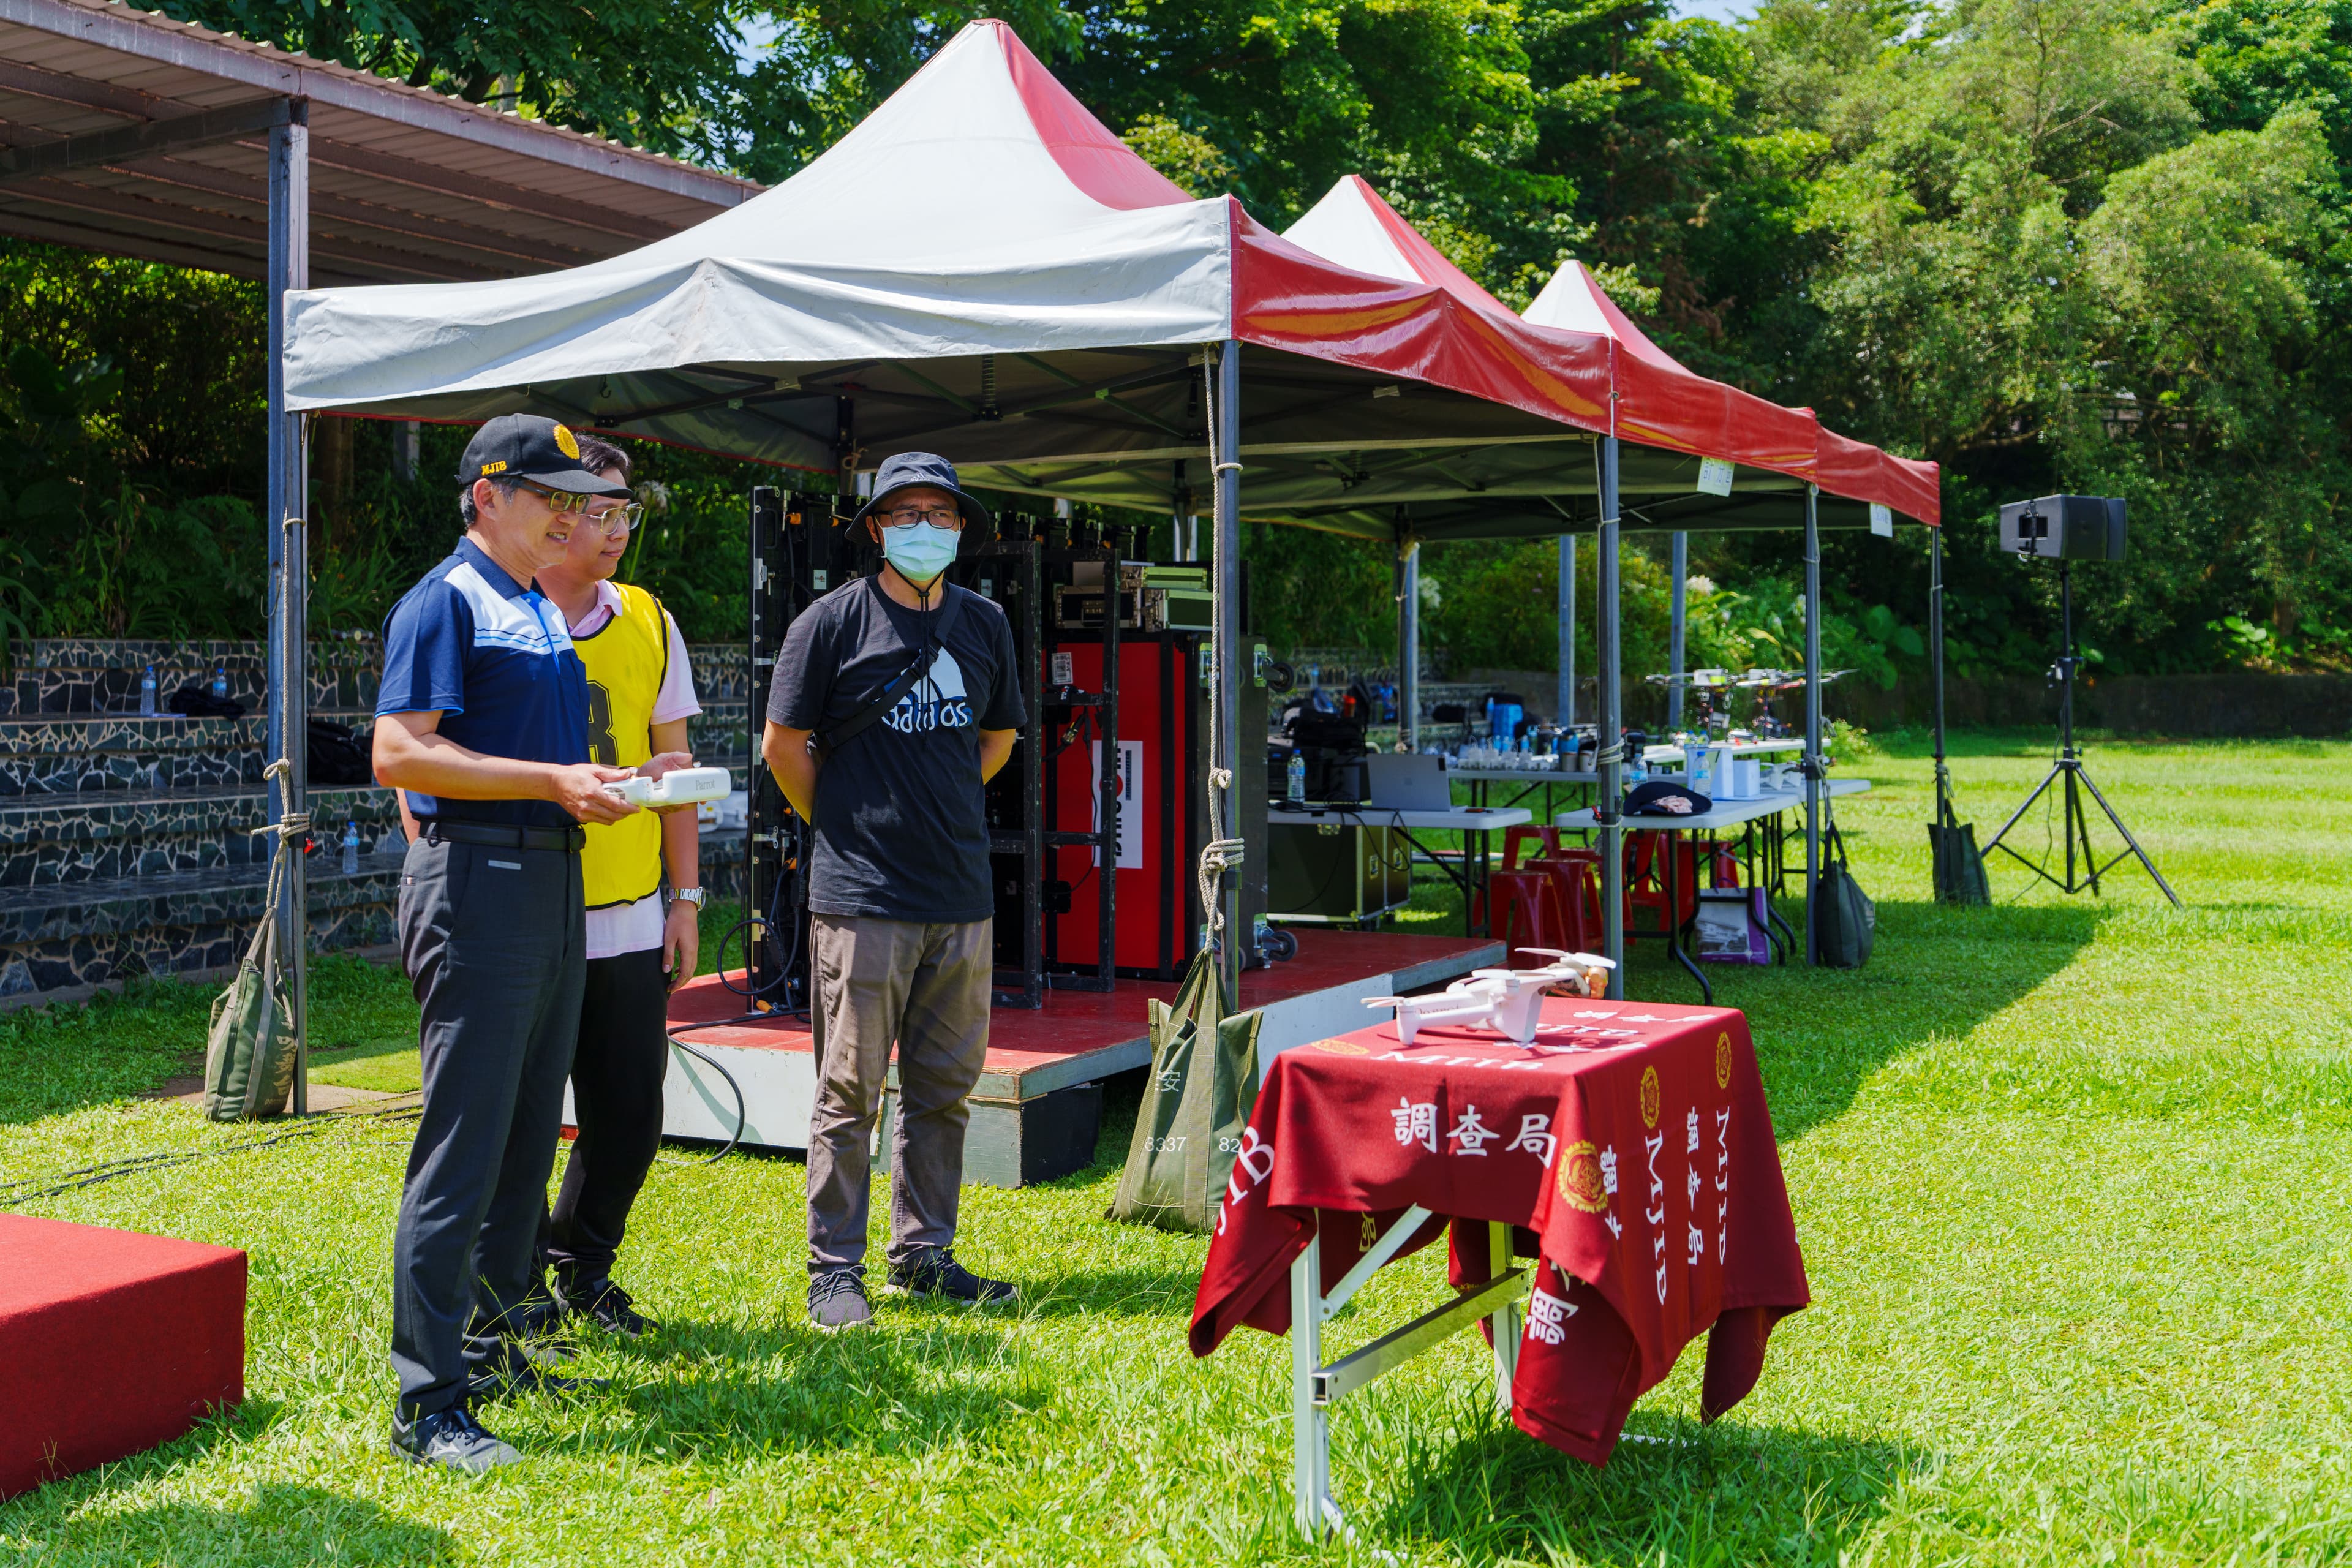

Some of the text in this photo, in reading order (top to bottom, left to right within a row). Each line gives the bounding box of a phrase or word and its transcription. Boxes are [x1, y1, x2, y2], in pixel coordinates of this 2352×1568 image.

[481, 461, 507, 476] MJIB
[695, 778, 715, 791] Parrot
[1390, 1096, 1557, 1169] 調查局
[1144, 1136, 1187, 1152] 8337
[1215, 1126, 1275, 1237] JIB
